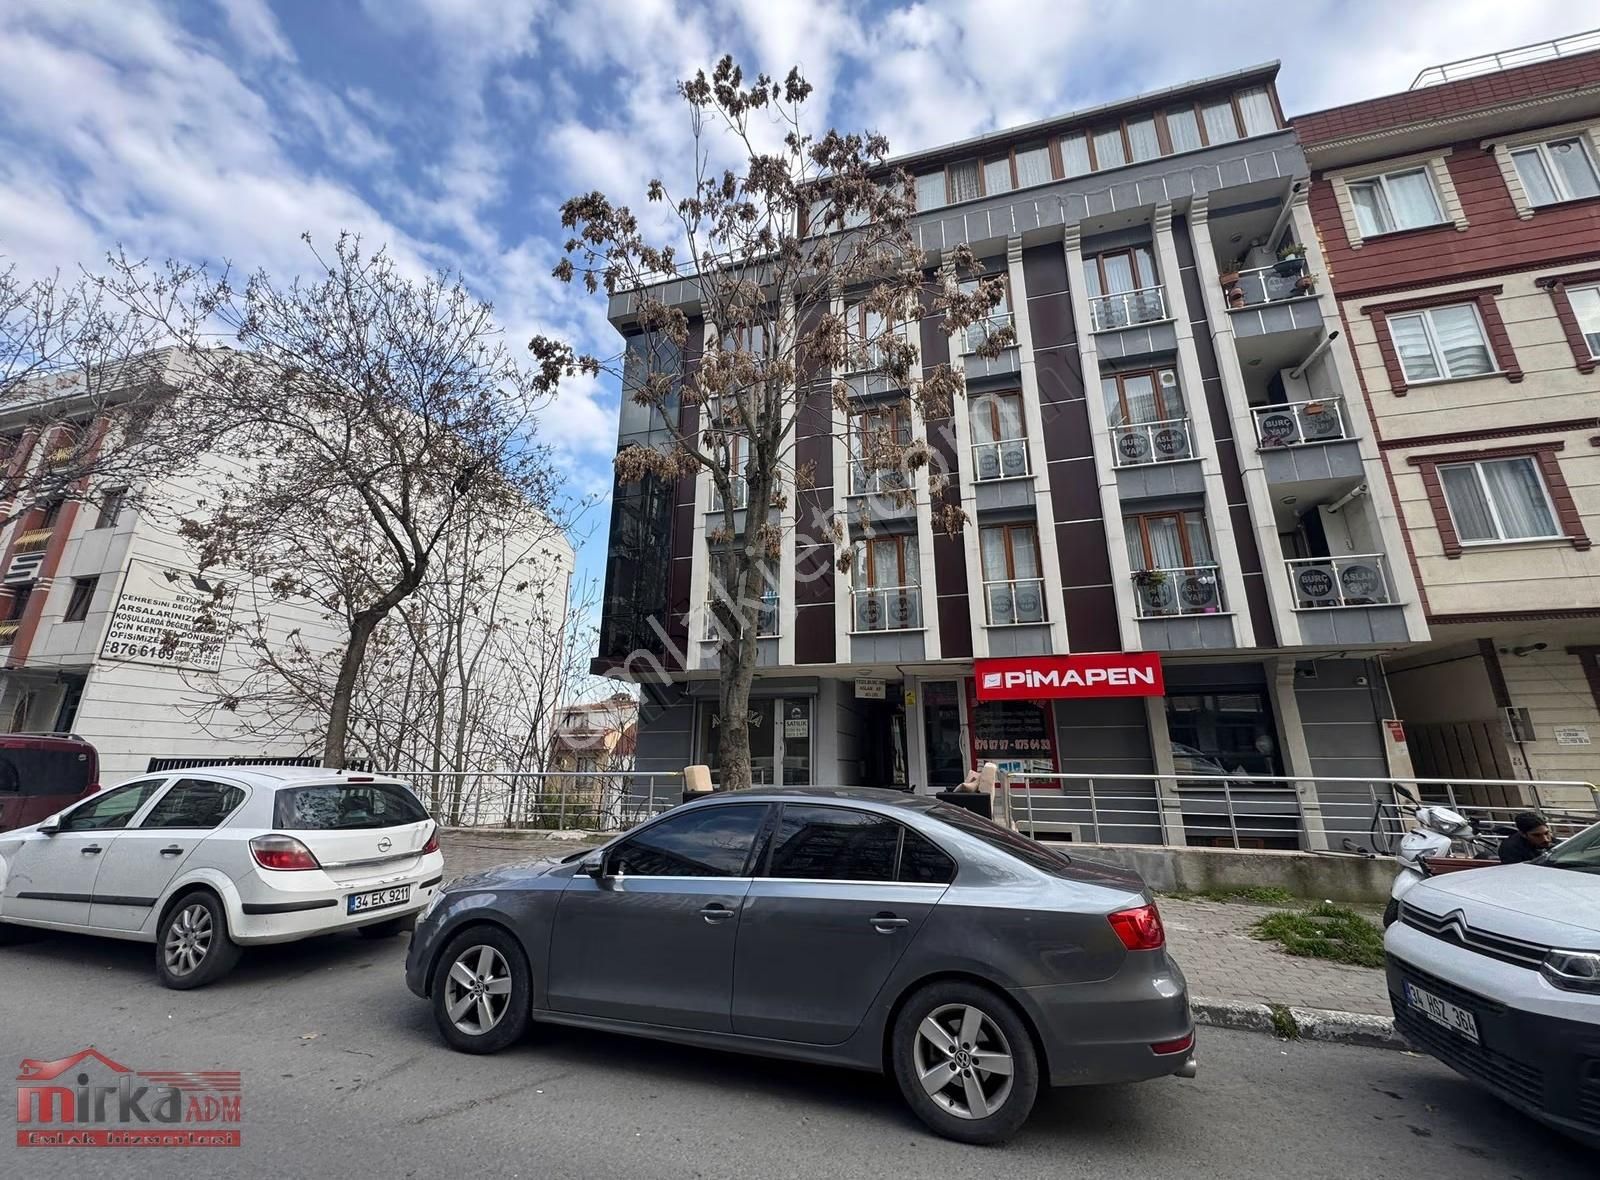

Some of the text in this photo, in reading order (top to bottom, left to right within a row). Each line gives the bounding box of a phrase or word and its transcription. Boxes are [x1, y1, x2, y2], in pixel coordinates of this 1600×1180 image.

[121, 593, 170, 608] ÇEHRESİNİ
[113, 621, 134, 631] İÇİN
[116, 612, 164, 627] KOŞULLARDA
[110, 630, 160, 644] OFİSİMİZE
[110, 641, 137, 656] 876
[355, 887, 409, 908] 34 EK 9211
[1409, 985, 1424, 1007] 34
[1452, 1006, 1477, 1036] 364
